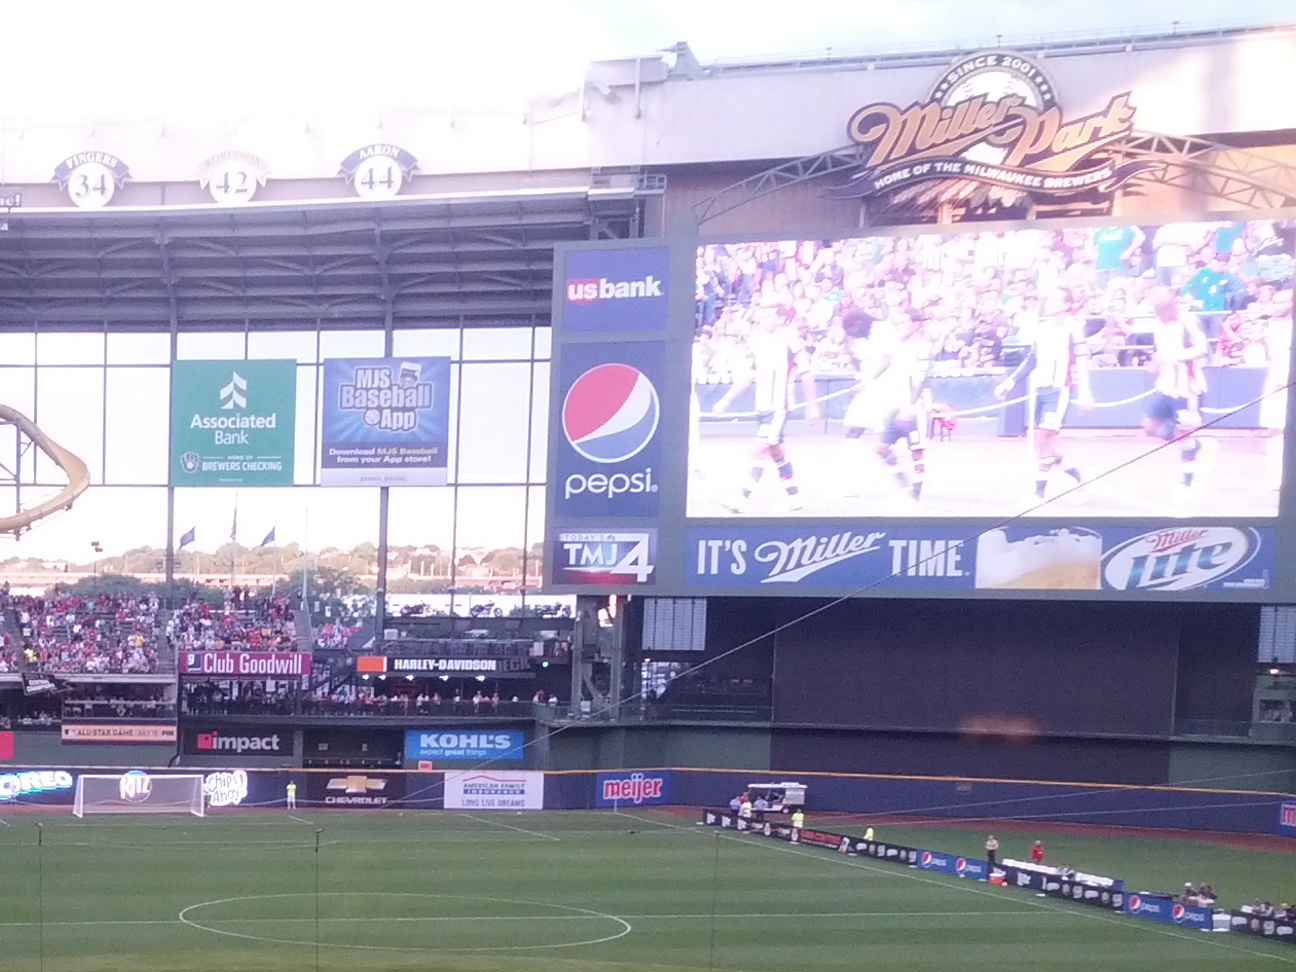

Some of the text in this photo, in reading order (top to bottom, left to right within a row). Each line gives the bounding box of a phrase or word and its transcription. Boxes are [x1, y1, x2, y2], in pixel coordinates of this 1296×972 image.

[947, 55, 1035, 83] SINCE 2001
[850, 91, 1137, 170] Miller Park
[66, 153, 118, 168] FINGERS
[360, 144, 401, 158] AARON
[75, 173, 108, 197] 34
[216, 172, 249, 194] 42
[361, 166, 395, 190] 44
[875, 162, 1112, 189] HOME OF THE MILWAUKEE BREWERS
[356, 368, 393, 390] MJS
[340, 384, 432, 408] Baseball
[190, 413, 277, 429] Associated
[378, 409, 415, 430] App
[214, 430, 249, 445] Bank
[329, 448, 375, 456] Download
[337, 455, 359, 463] from
[383, 455, 403, 464] App
[404, 455, 431, 463] store!
[202, 462, 283, 473] BREWERS CHECKING
[1145, 528, 1209, 553] Miller
[697, 539, 747, 575] IT'S
[754, 531, 886, 583] Miller
[1124, 540, 1234, 590] Lite
[203, 654, 303, 676] Club Goodwill
[394, 658, 497, 671] HARLEY-DAVIDSON
[212, 731, 280, 752] impact
[420, 734, 512, 749] KOHL'S
[444, 749, 464, 757] great
[120, 773, 151, 800] RITZ
[604, 774, 663, 803] meijer
[325, 796, 388, 805] CHEVROLET
